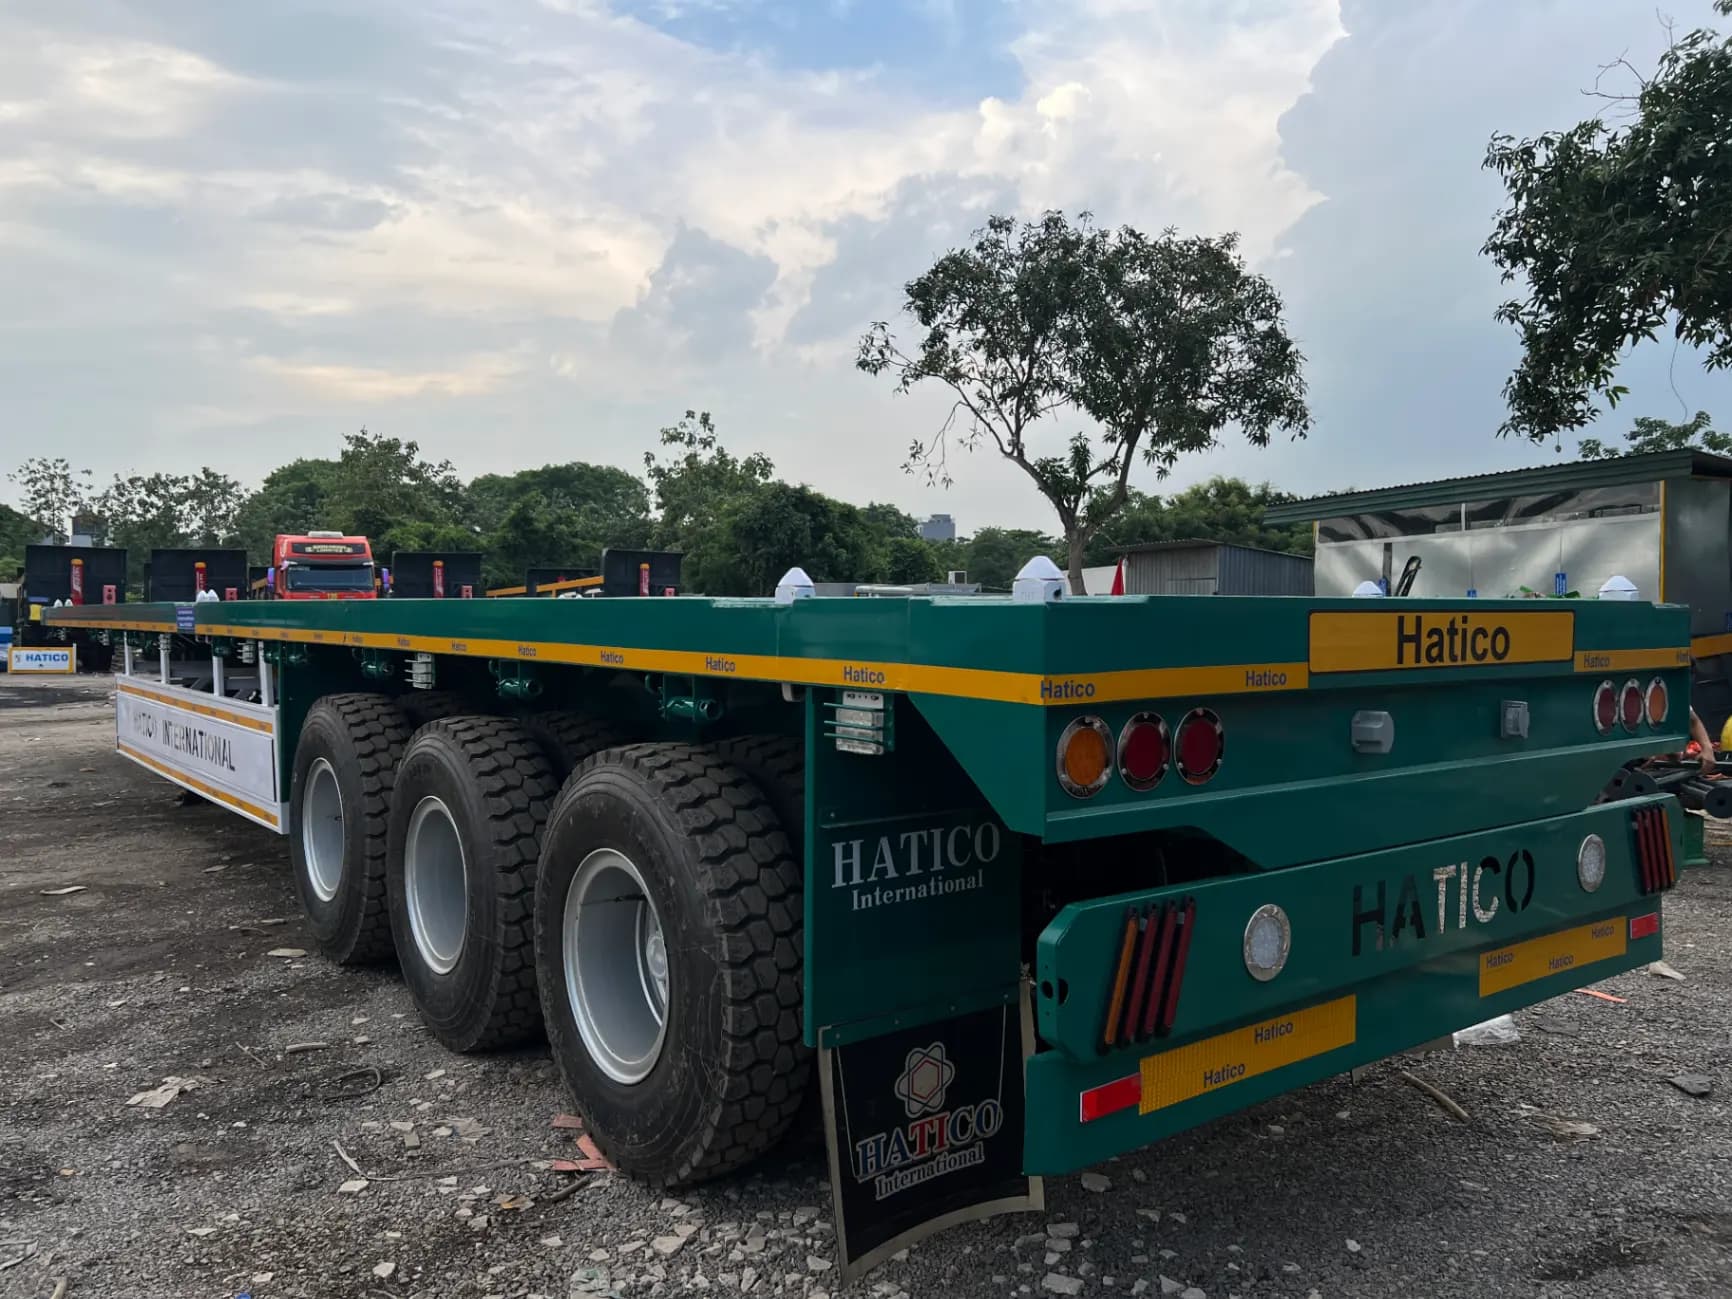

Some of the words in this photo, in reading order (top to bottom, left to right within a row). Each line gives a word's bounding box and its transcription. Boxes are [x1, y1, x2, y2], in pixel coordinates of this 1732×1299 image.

[1397, 615, 1511, 665] Hatico
[26, 653, 69, 662] HATICO
[600, 651, 624, 664] Hatico
[705, 656, 736, 673] Hatico
[1583, 654, 1610, 669] Hatico
[843, 665, 885, 684] Hatico
[1245, 670, 1287, 688] Hatico
[1040, 680, 1096, 699] Hatico
[162, 719, 235, 772] INTERNATIONAL
[831, 822, 1000, 888] HATICO
[852, 868, 984, 911] International
[1352, 849, 1535, 957] HATICO
[1591, 926, 1615, 939] Hatico
[1486, 952, 1514, 969] Hatico
[1548, 955, 1575, 971] Hatico
[1254, 1022, 1294, 1045] Hatico
[1203, 1063, 1246, 1089] Hatico
[856, 1099, 1004, 1184] HATICO
[874, 1141, 986, 1201] International
